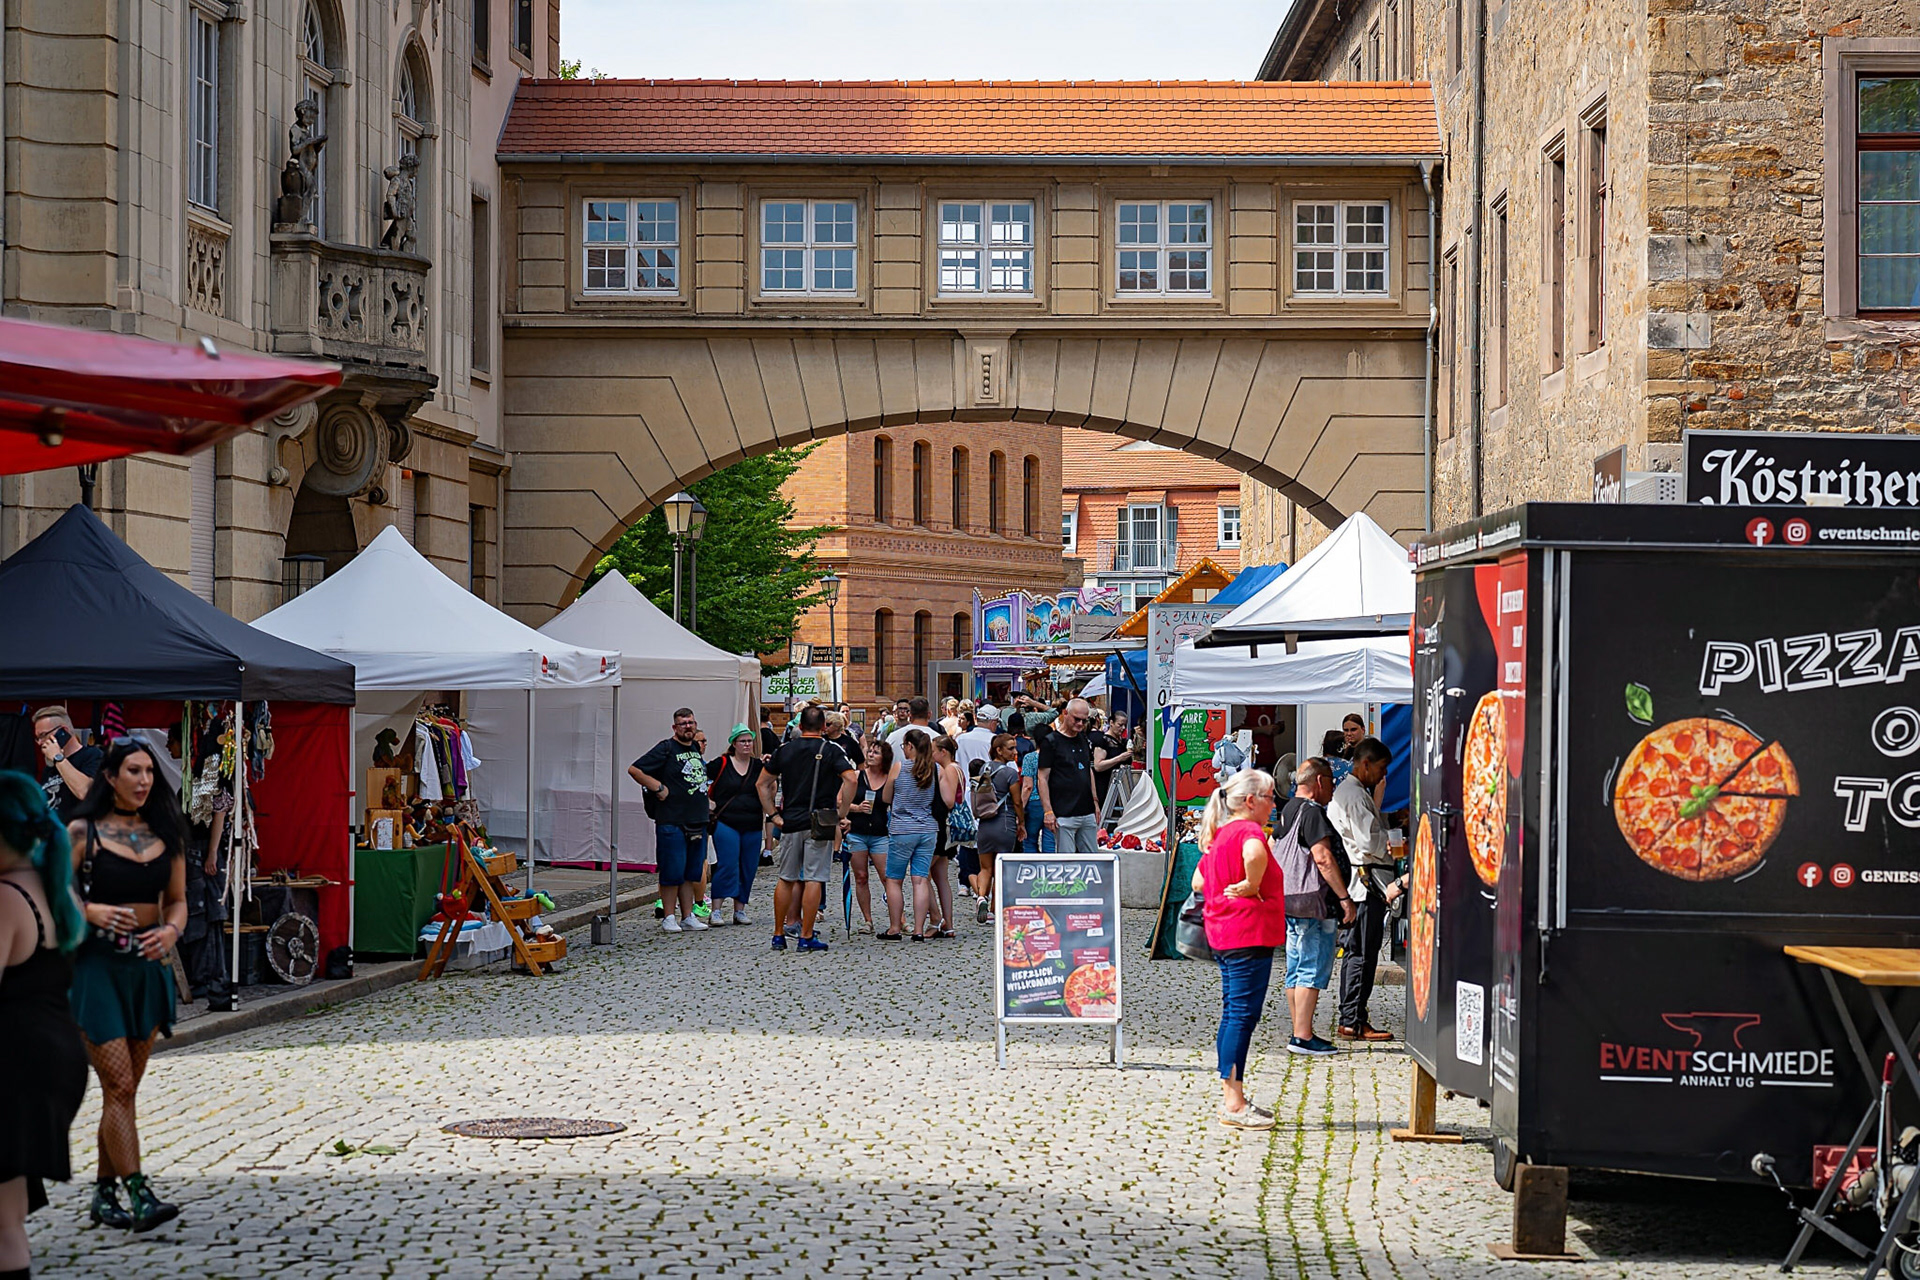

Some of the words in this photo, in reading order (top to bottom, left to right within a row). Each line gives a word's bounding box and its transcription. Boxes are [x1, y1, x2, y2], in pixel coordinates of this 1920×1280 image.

[1700, 449, 1920, 507] Köstritzer
[770, 677, 815, 685] FRISHER
[1016, 864, 1102, 885] PIZZA
[1861, 870, 1920, 883] GENIES
[1011, 966, 1053, 982] HERZLICH
[1006, 975, 1066, 992] WILLKOMMEN
[1600, 1042, 1834, 1076] EVENTSCHMIEDE
[1680, 1075, 1731, 1087] ANHALT
[1736, 1077, 1754, 1088] UG
